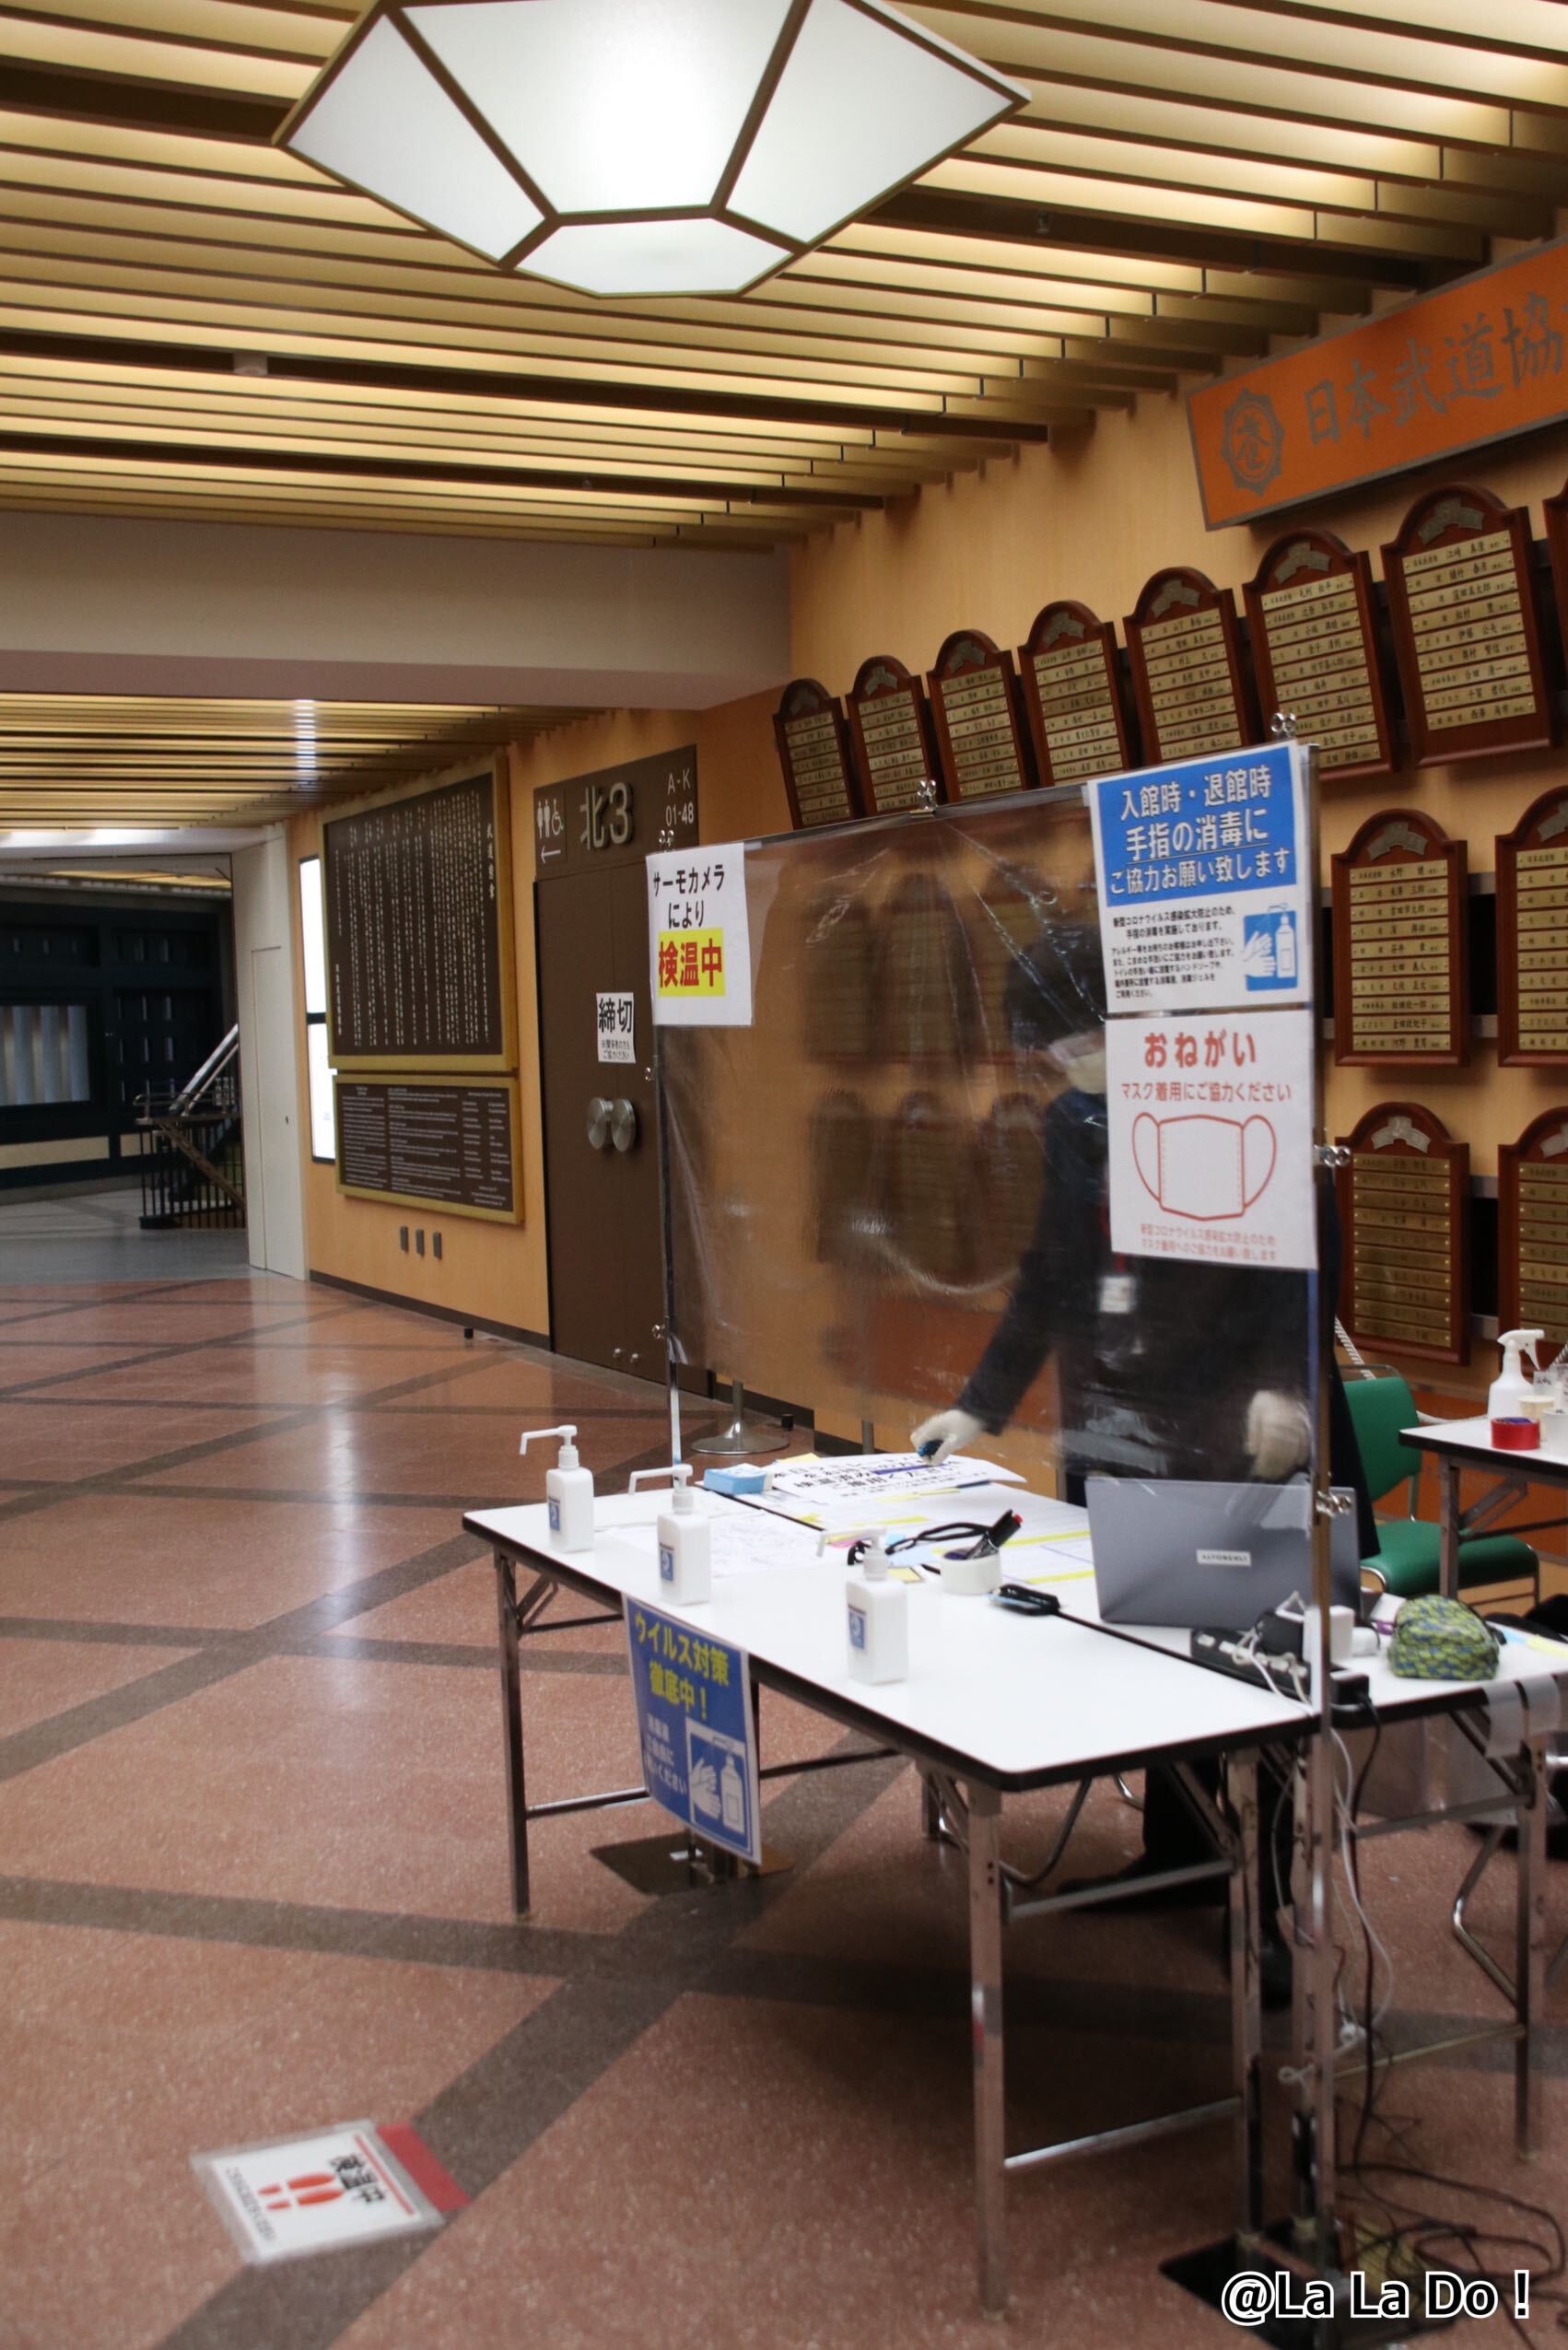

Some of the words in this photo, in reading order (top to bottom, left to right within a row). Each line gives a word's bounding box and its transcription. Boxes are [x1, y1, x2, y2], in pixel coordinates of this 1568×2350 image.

[1303, 291, 1568, 445] 日本武道協
[579, 781, 633, 850] 北3
[1120, 766, 1271, 822] 入館時・退館時
[1126, 808, 1269, 861] 手指の消毒に
[652, 863, 725, 897] サーモカメラ
[1111, 848, 1291, 895] ご協力お願い致します
[668, 899, 705, 929] により
[658, 938, 722, 988] 検温中
[598, 997, 633, 1034] 締切
[1144, 1029, 1257, 1069] おねがい
[1121, 1081, 1293, 1104] マスク着用にご協力ください
[635, 1611, 730, 1686] ウイルス対策
